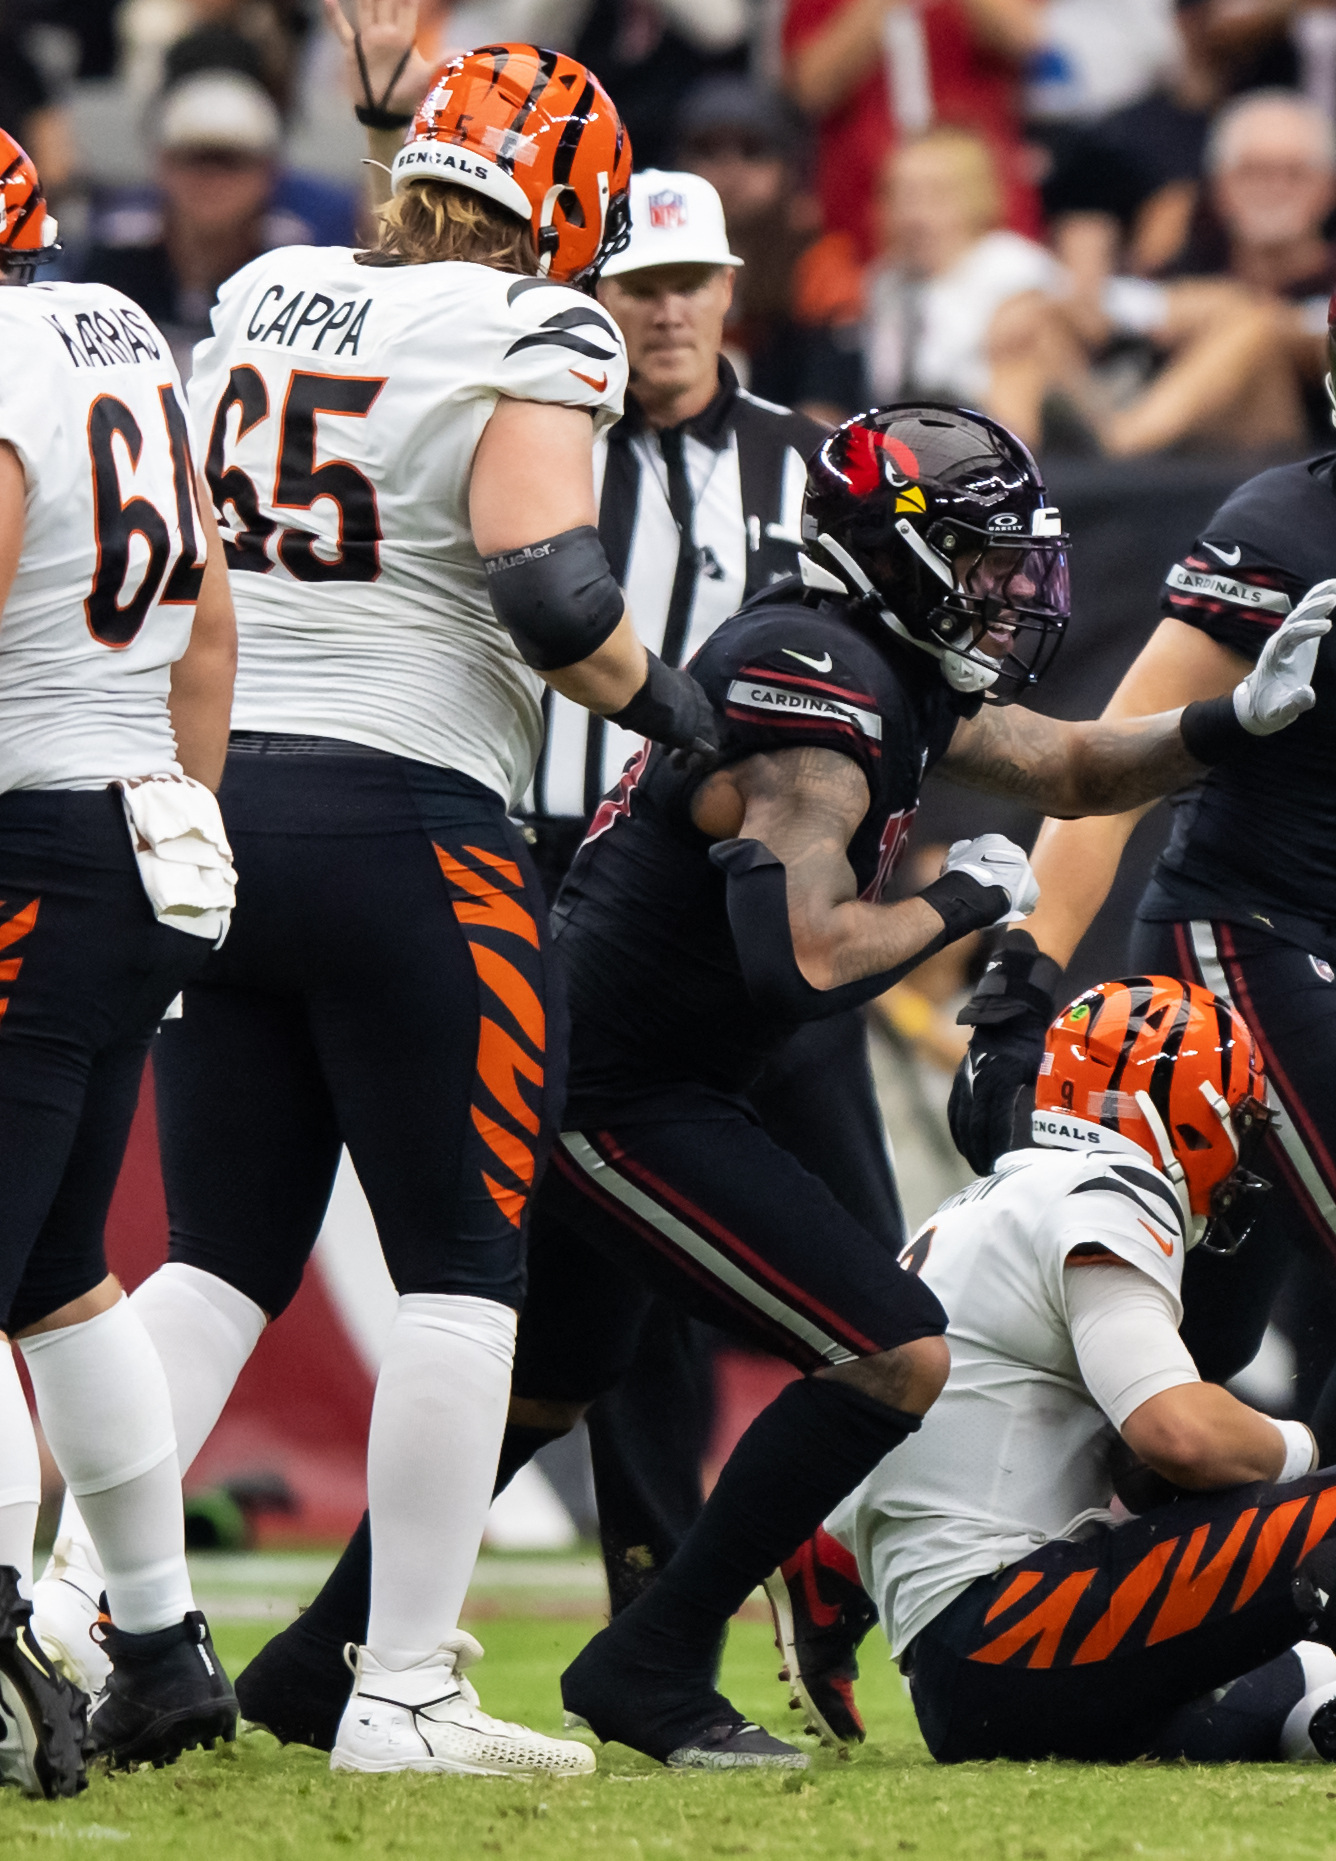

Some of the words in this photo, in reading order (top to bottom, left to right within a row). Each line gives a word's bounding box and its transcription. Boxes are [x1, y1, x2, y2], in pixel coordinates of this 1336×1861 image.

[246, 284, 374, 357] CAPPA
[204, 362, 390, 584] 65
[1176, 572, 1263, 603] CARDINALS
[1059, 1079, 1075, 1111] 9
[1032, 1119, 1101, 1144] ENGALS
